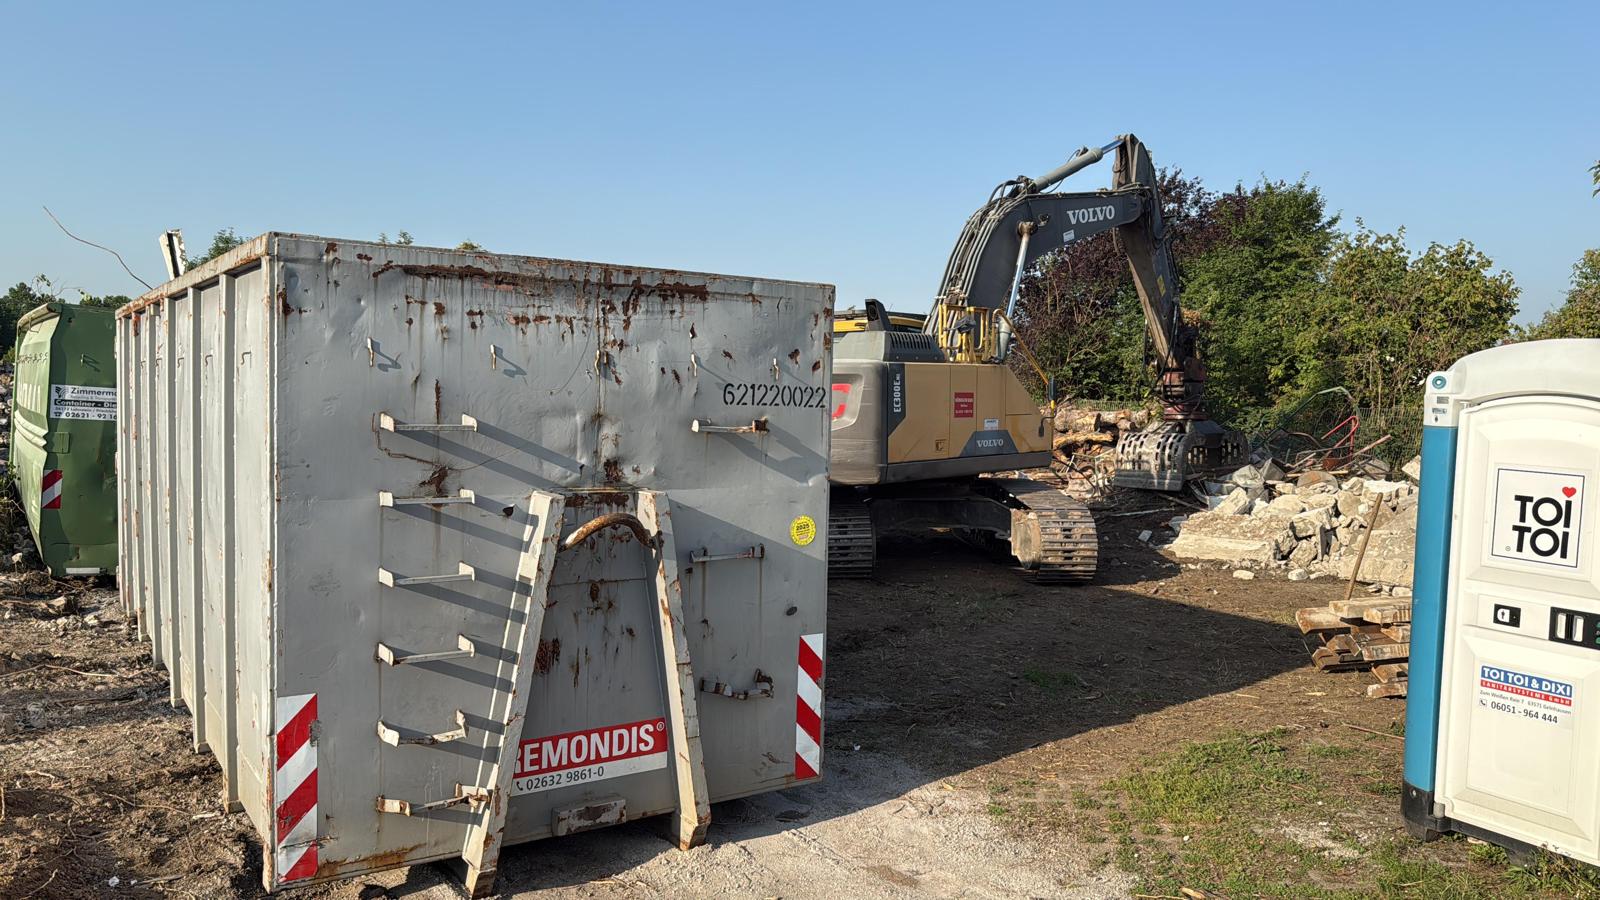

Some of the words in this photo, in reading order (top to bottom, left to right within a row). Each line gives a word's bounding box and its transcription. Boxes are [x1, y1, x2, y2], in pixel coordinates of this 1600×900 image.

[1067, 205, 1115, 225] VOLVO
[723, 383, 826, 408] 621220022
[976, 439, 1003, 448] VOLVO
[1514, 494, 1572, 528] TOI
[1512, 524, 1569, 559] TOI
[1483, 667, 1504, 682] TOI
[1507, 673, 1528, 687] TOI
[1531, 678, 1539, 689] &
[1542, 681, 1570, 696] DIXI
[1491, 701, 1516, 714] 06051
[1523, 709, 1539, 719] 964
[1541, 713, 1558, 723] 444
[526, 774, 562, 791] 02632
[566, 766, 604, 783] 9861-0
